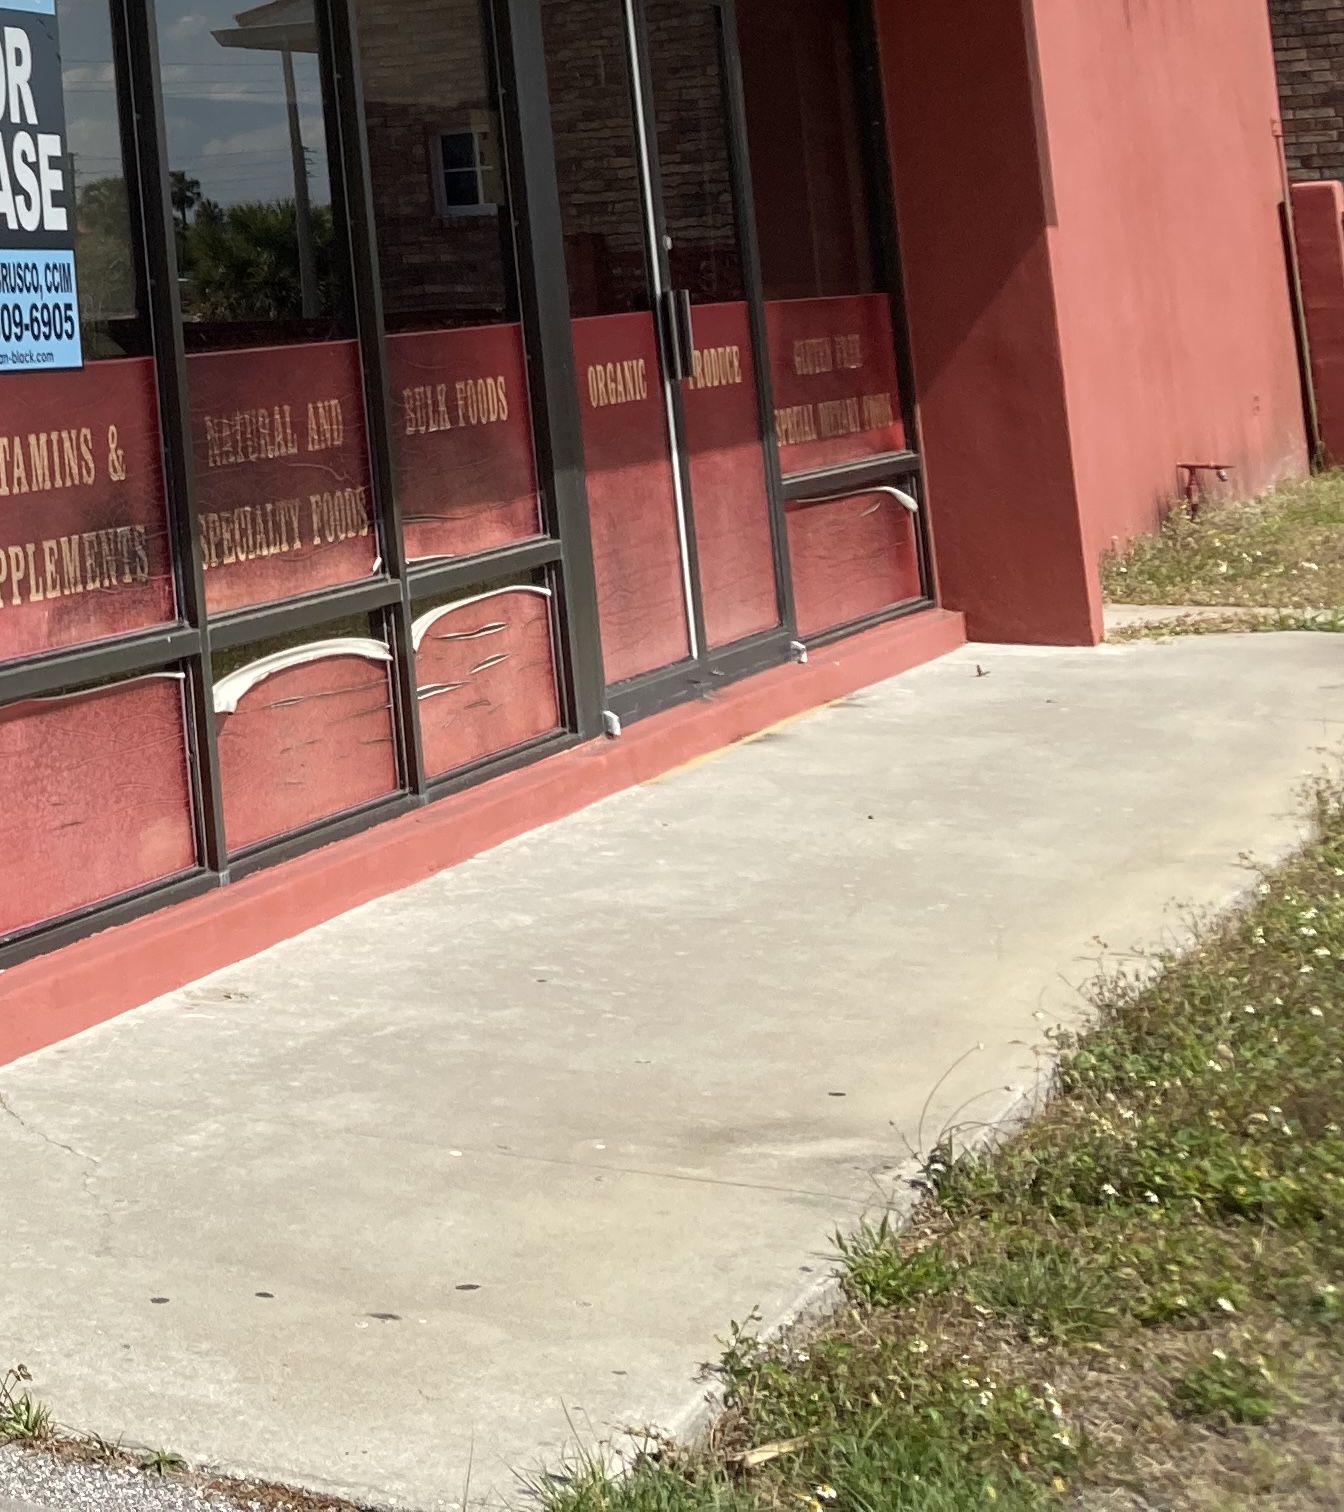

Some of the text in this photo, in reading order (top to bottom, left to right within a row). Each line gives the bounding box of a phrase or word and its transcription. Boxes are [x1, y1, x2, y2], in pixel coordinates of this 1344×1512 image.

[44, 262, 73, 293] CCIM
[455, 375, 508, 427] FOODS
[588, 358, 647, 408] ORGANIC
[308, 399, 343, 451] AND
[108, 424, 126, 483] &
[310, 488, 369, 546] FOODS
